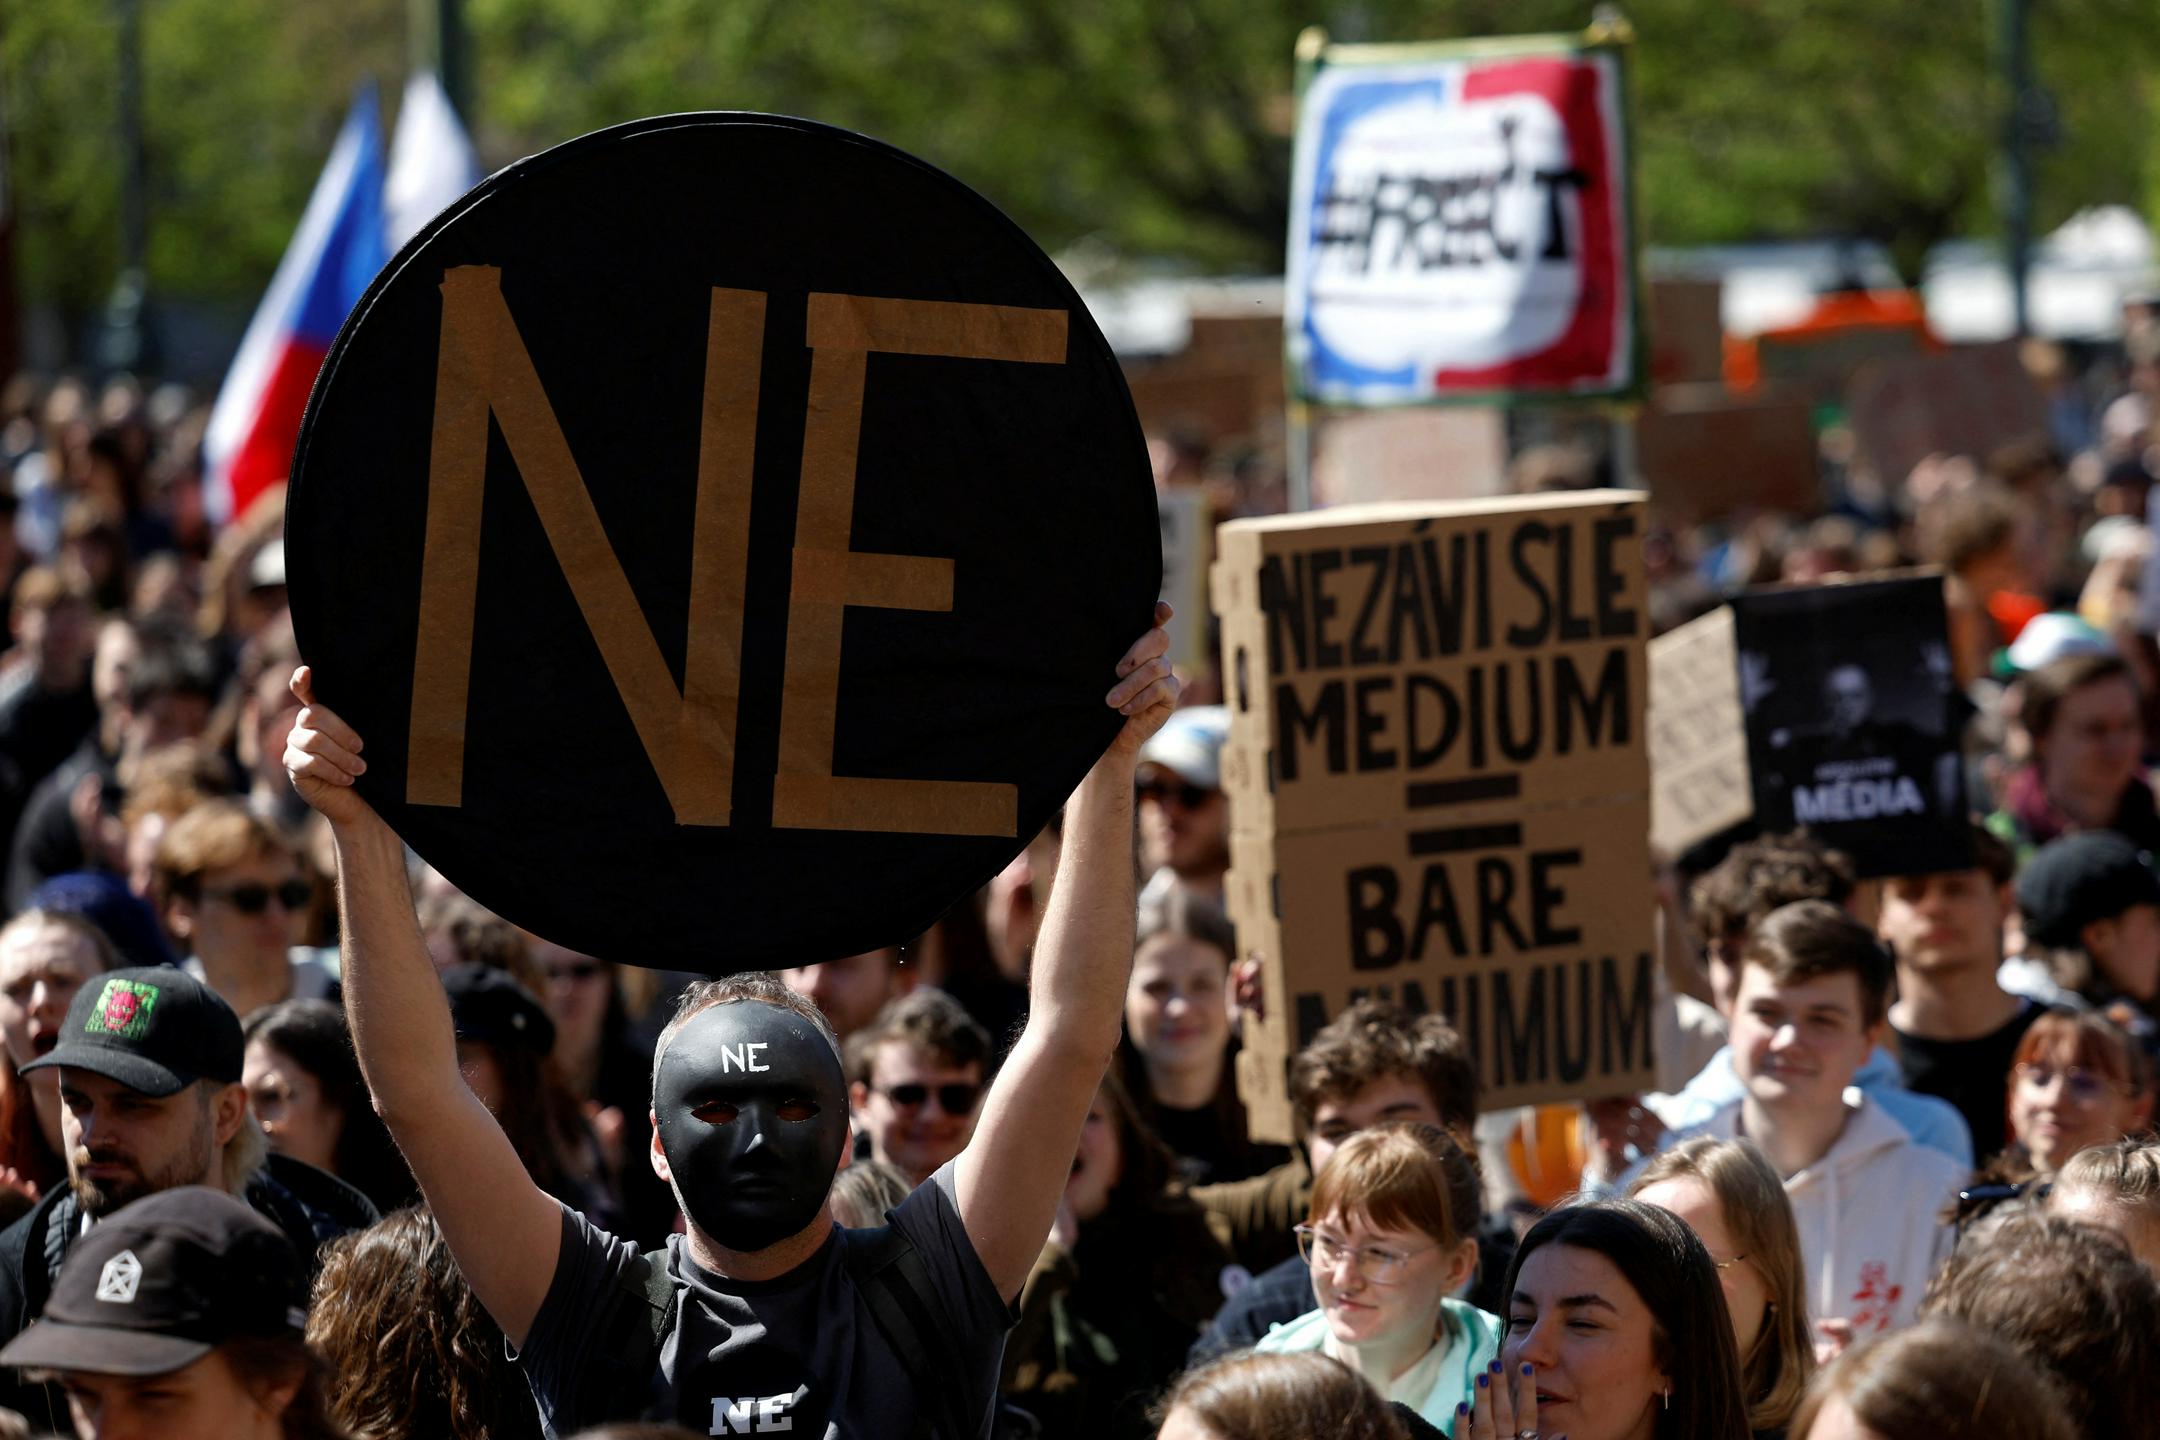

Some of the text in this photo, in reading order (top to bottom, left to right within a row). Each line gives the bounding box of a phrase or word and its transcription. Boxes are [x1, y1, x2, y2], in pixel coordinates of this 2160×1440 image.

[406, 264, 1069, 838] NE
[1274, 649, 1629, 781] MEDIUM
[1347, 849, 1582, 972] BARE
[721, 1042, 770, 1073] NE
[1295, 952, 1654, 1088] IMUM
[709, 1392, 793, 1436] NE
